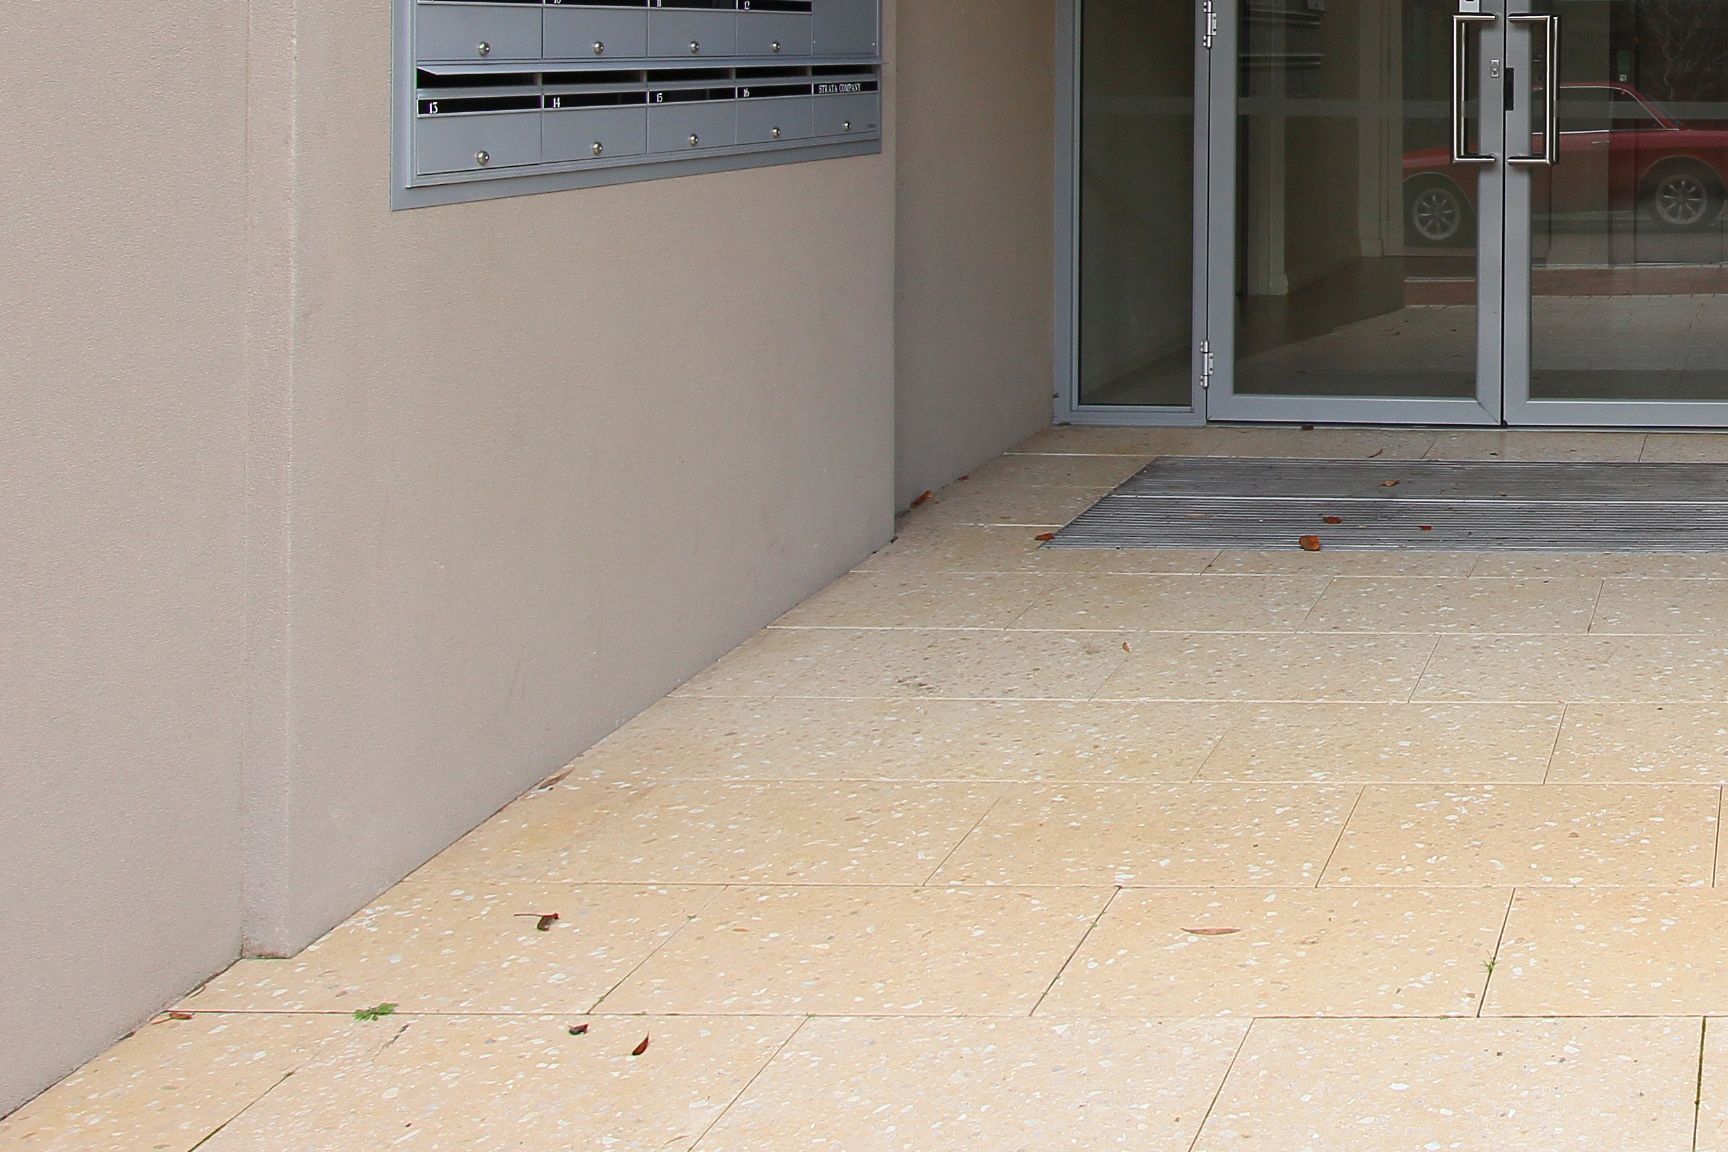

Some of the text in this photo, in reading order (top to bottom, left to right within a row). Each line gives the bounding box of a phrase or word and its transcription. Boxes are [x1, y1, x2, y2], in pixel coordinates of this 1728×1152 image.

[744, 0, 751, 10] 12
[818, 83, 861, 94] STRATA COMPANY
[553, 97, 561, 108] 14
[656, 92, 663, 103] 15
[429, 101, 439, 114] 13
